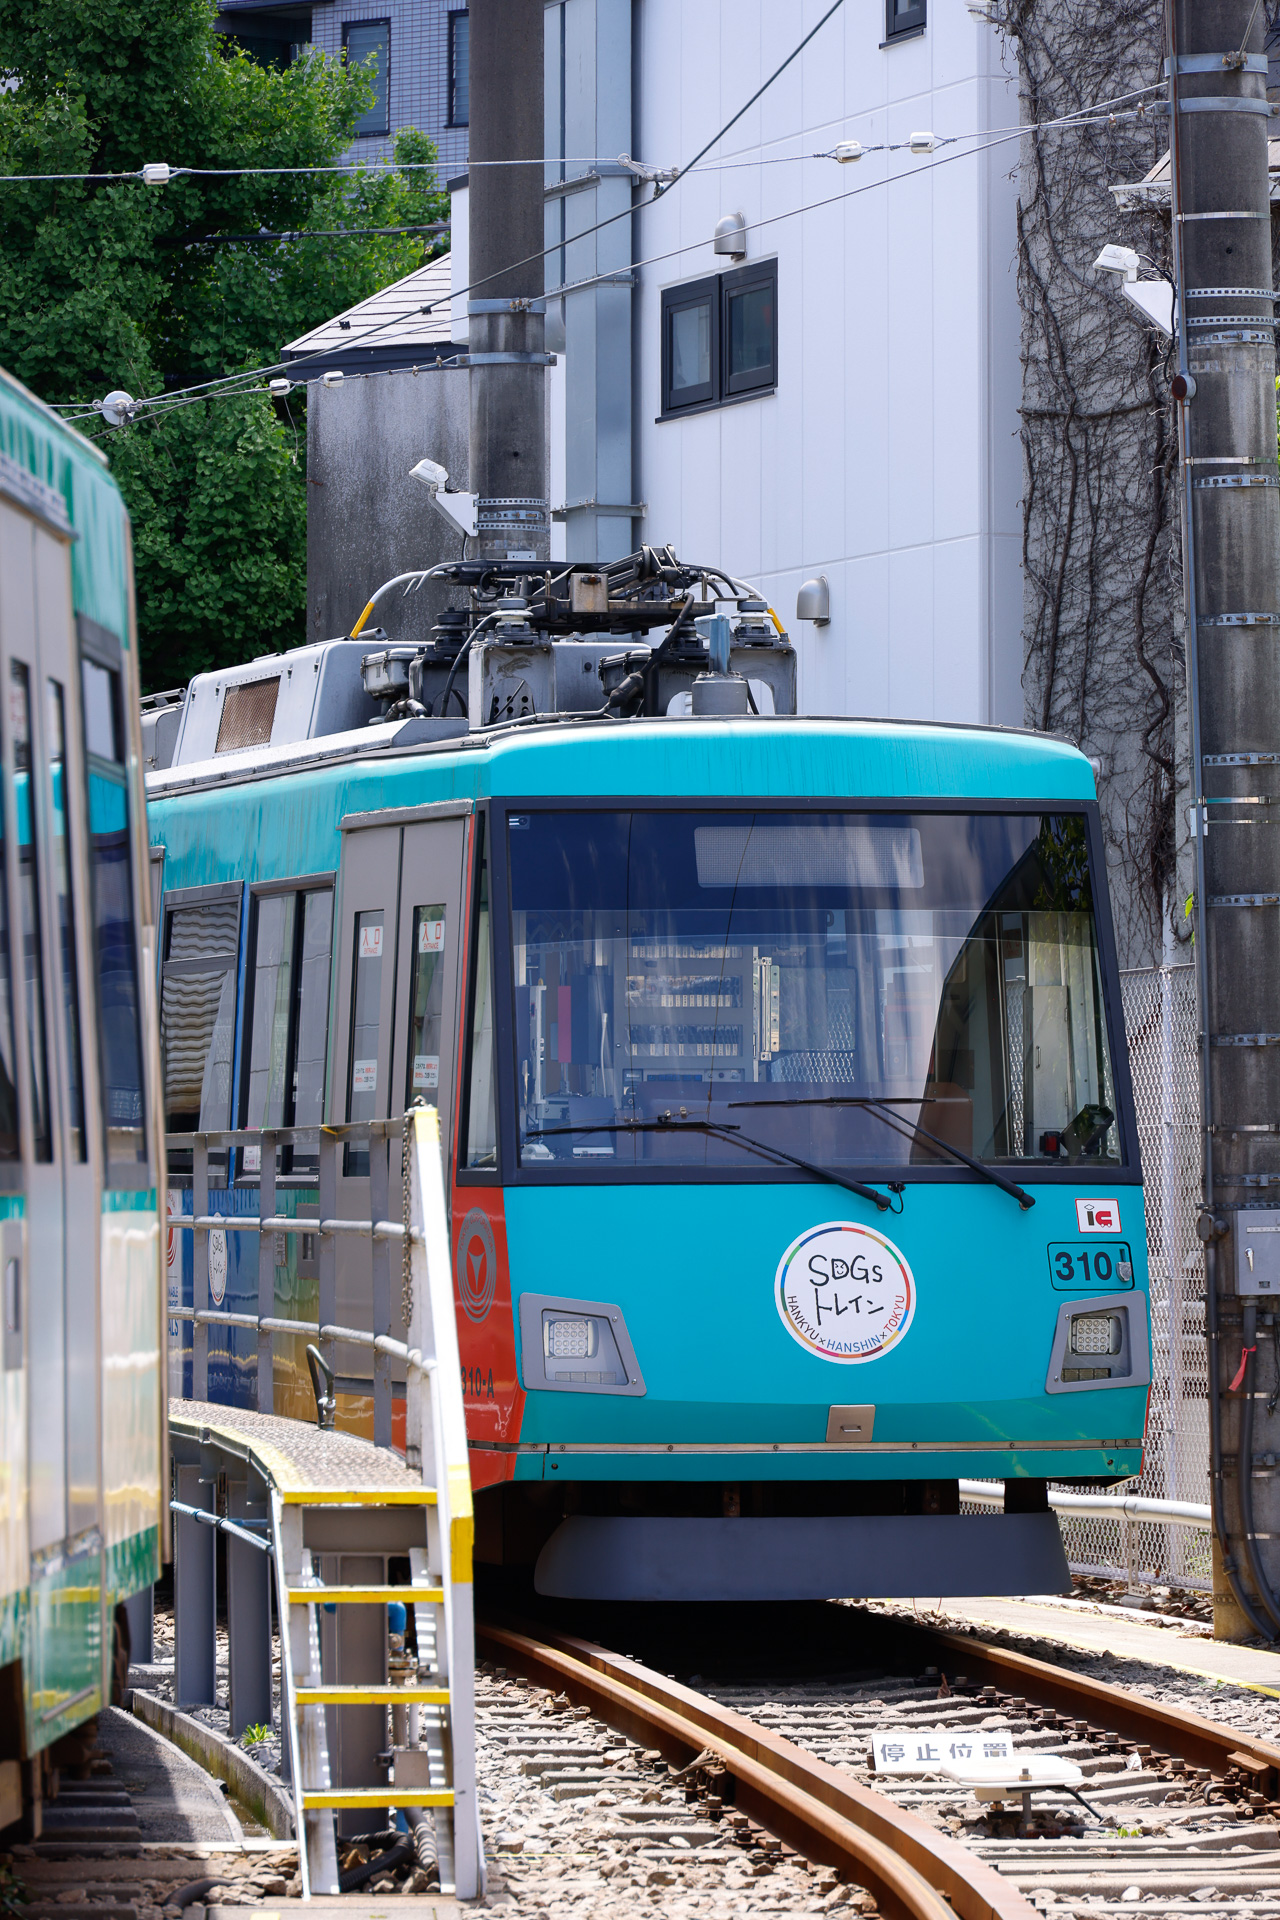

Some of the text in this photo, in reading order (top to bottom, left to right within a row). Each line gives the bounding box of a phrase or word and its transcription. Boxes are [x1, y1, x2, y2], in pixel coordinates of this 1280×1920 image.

[362, 928, 380, 947] 入口
[422, 923, 442, 942] 入口
[423, 942, 439, 951] ENTRANCE
[808, 1254, 883, 1287] SDGs
[1055, 1251, 1112, 1281] 310
[814, 1287, 885, 1326] トレイン
[787, 1295, 820, 1341] HANKYU
[826, 1334, 881, 1353] HANSHIN
[883, 1295, 905, 1333] TOKYU
[880, 1743, 1008, 1763] 停止位置
